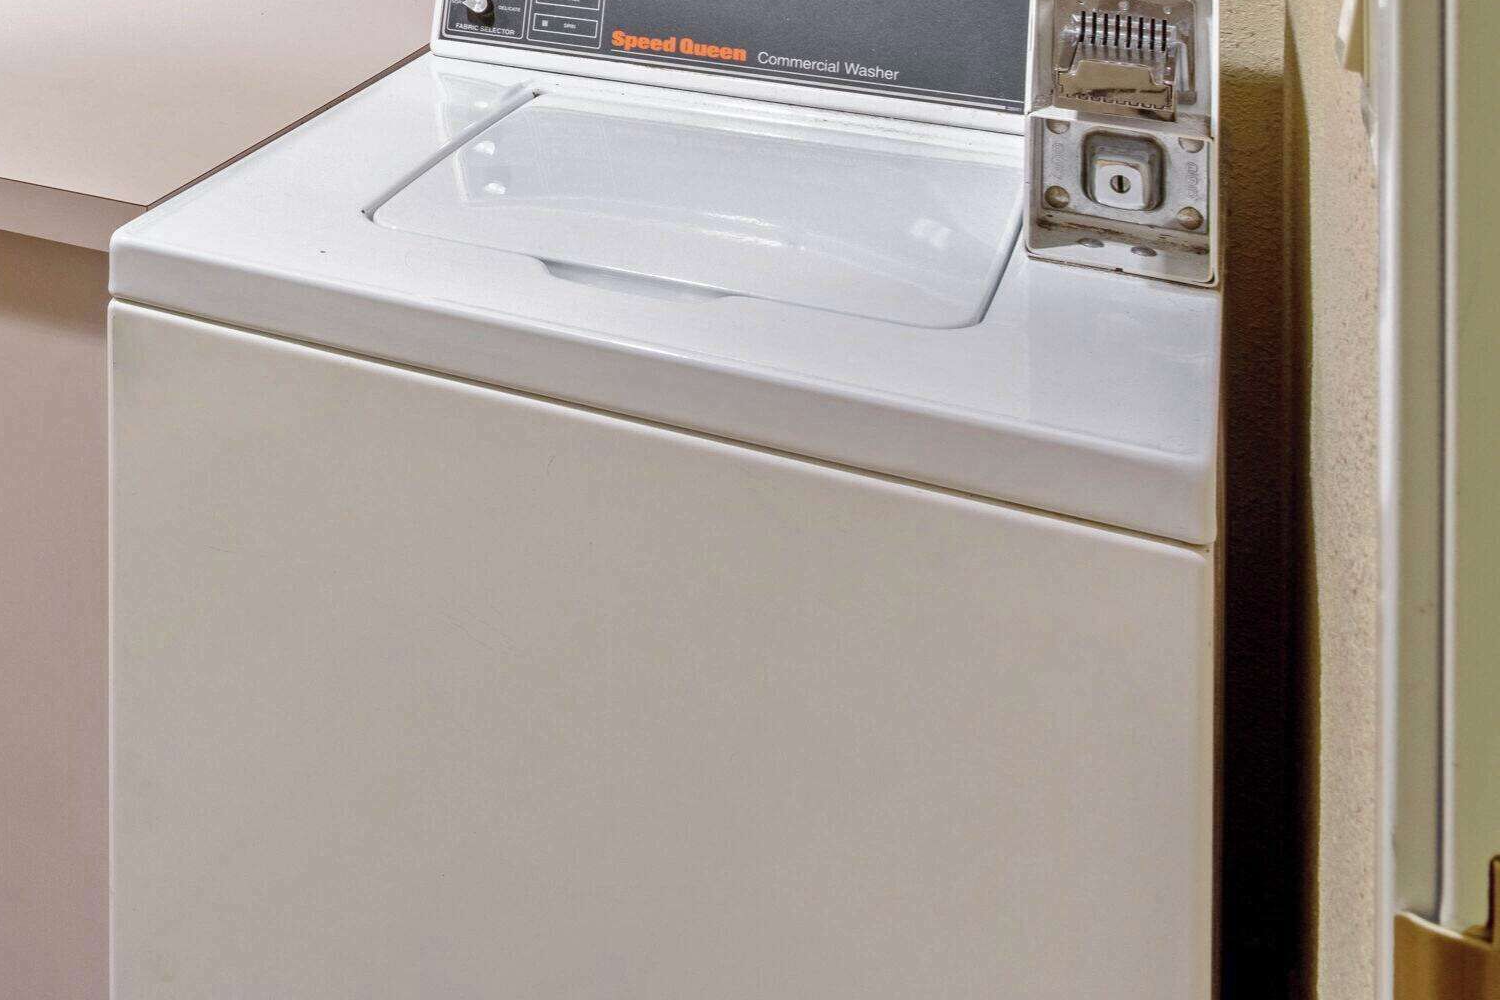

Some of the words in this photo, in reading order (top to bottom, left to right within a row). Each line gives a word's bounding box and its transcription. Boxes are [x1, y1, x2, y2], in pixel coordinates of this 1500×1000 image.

[455, 22, 479, 31] FABRIC
[480, 26, 515, 35] SELECTOR
[611, 30, 676, 52] Speed
[679, 37, 747, 62] Queen
[757, 51, 840, 74] Commercial
[844, 62, 900, 81] Washer
